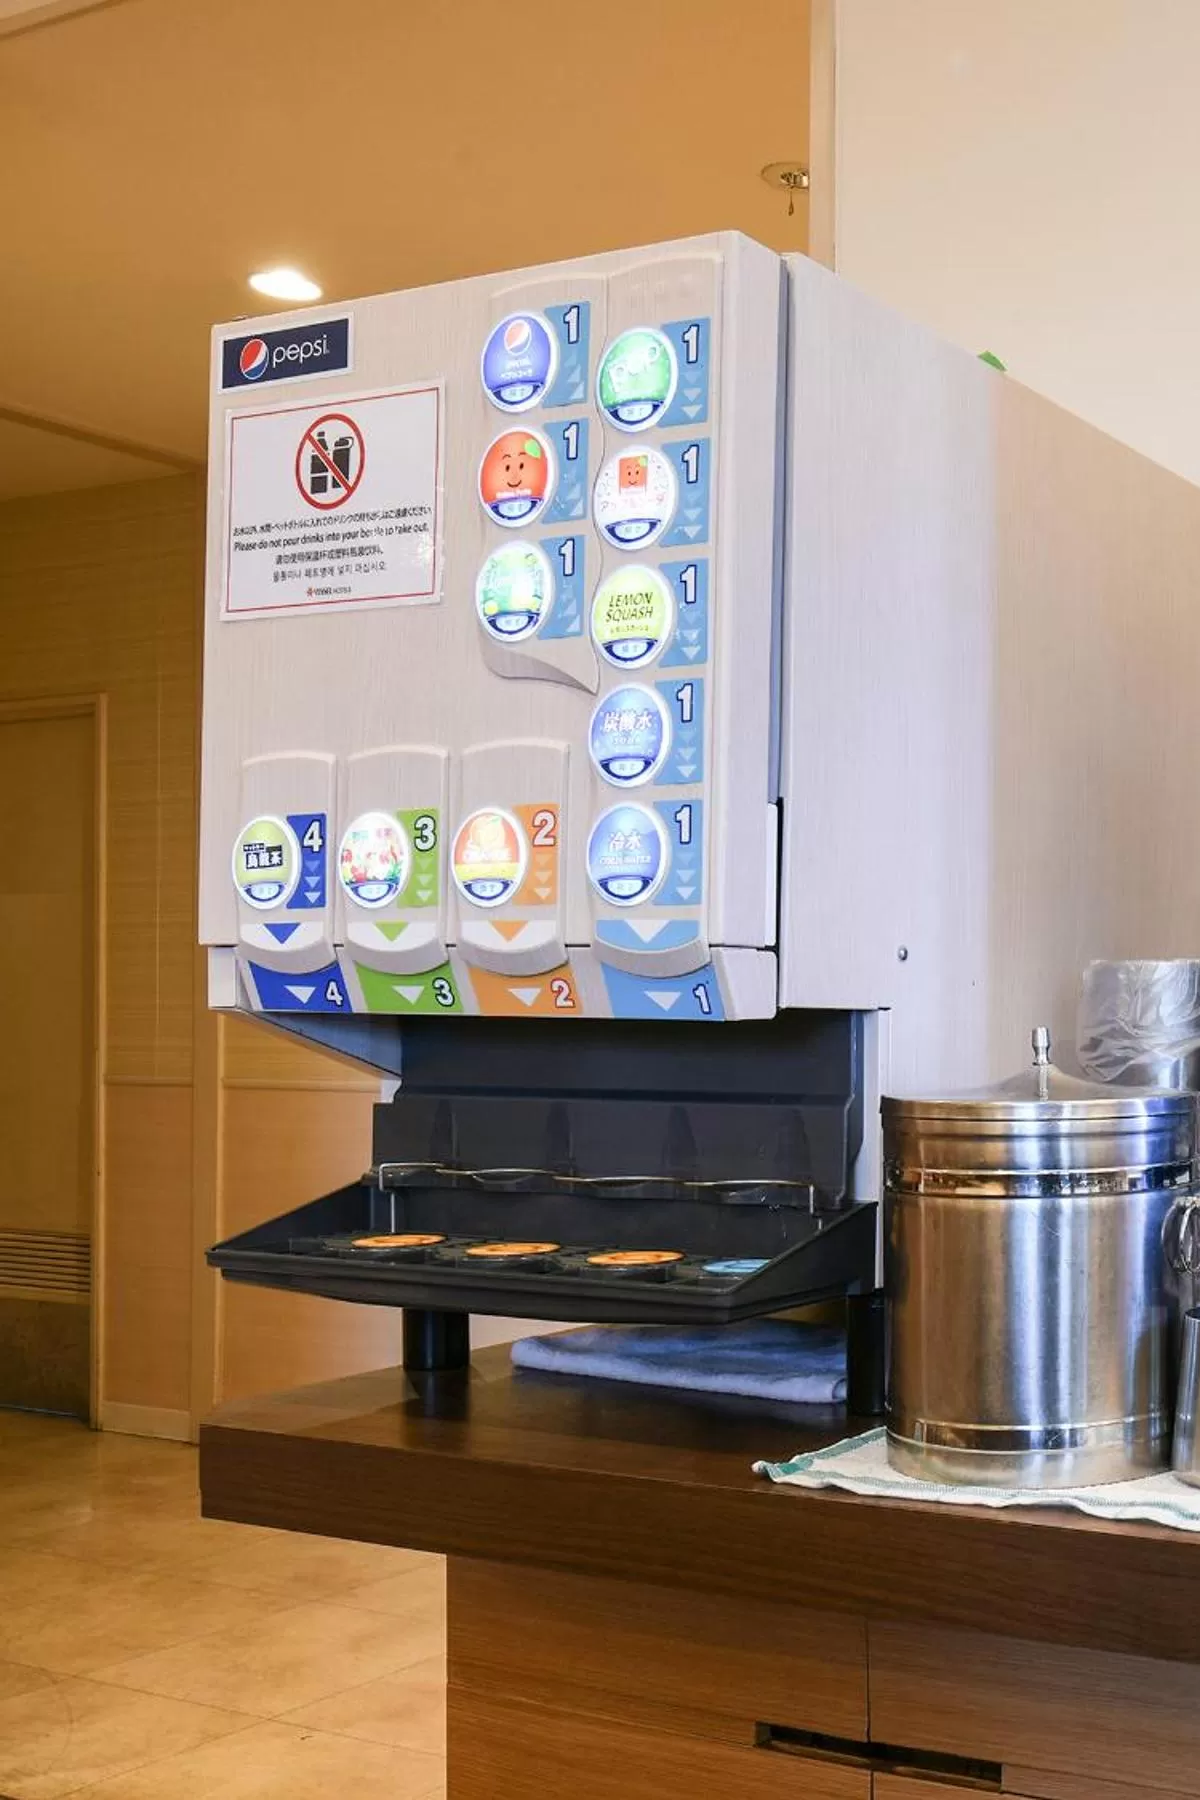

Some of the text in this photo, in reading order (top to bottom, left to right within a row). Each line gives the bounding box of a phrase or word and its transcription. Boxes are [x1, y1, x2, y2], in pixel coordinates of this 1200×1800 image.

[563, 305, 580, 344] 1
[272, 334, 327, 368] pepsi
[682, 324, 700, 364] 1
[563, 422, 580, 460] 1
[682, 444, 700, 484] 1
[234, 541, 257, 552] Please
[257, 540, 268, 549] do
[269, 539, 282, 548] not
[282, 536, 300, 548] pour
[300, 533, 324, 545] drinks
[325, 531, 341, 541] into
[341, 529, 360, 543] your
[559, 538, 576, 576] 1
[609, 592, 653, 608] LEMON
[680, 564, 697, 604] 1
[605, 606, 653, 623] SQUASH
[676, 683, 693, 723] 1
[302, 819, 324, 853] 4
[414, 814, 437, 852] 3
[532, 809, 557, 847] 2
[608, 828, 641, 851] 冷水
[675, 804, 692, 845] 1
[325, 979, 344, 1007] 4
[432, 977, 455, 1008] 3
[550, 979, 576, 1008] 2
[693, 983, 713, 1014] 1
